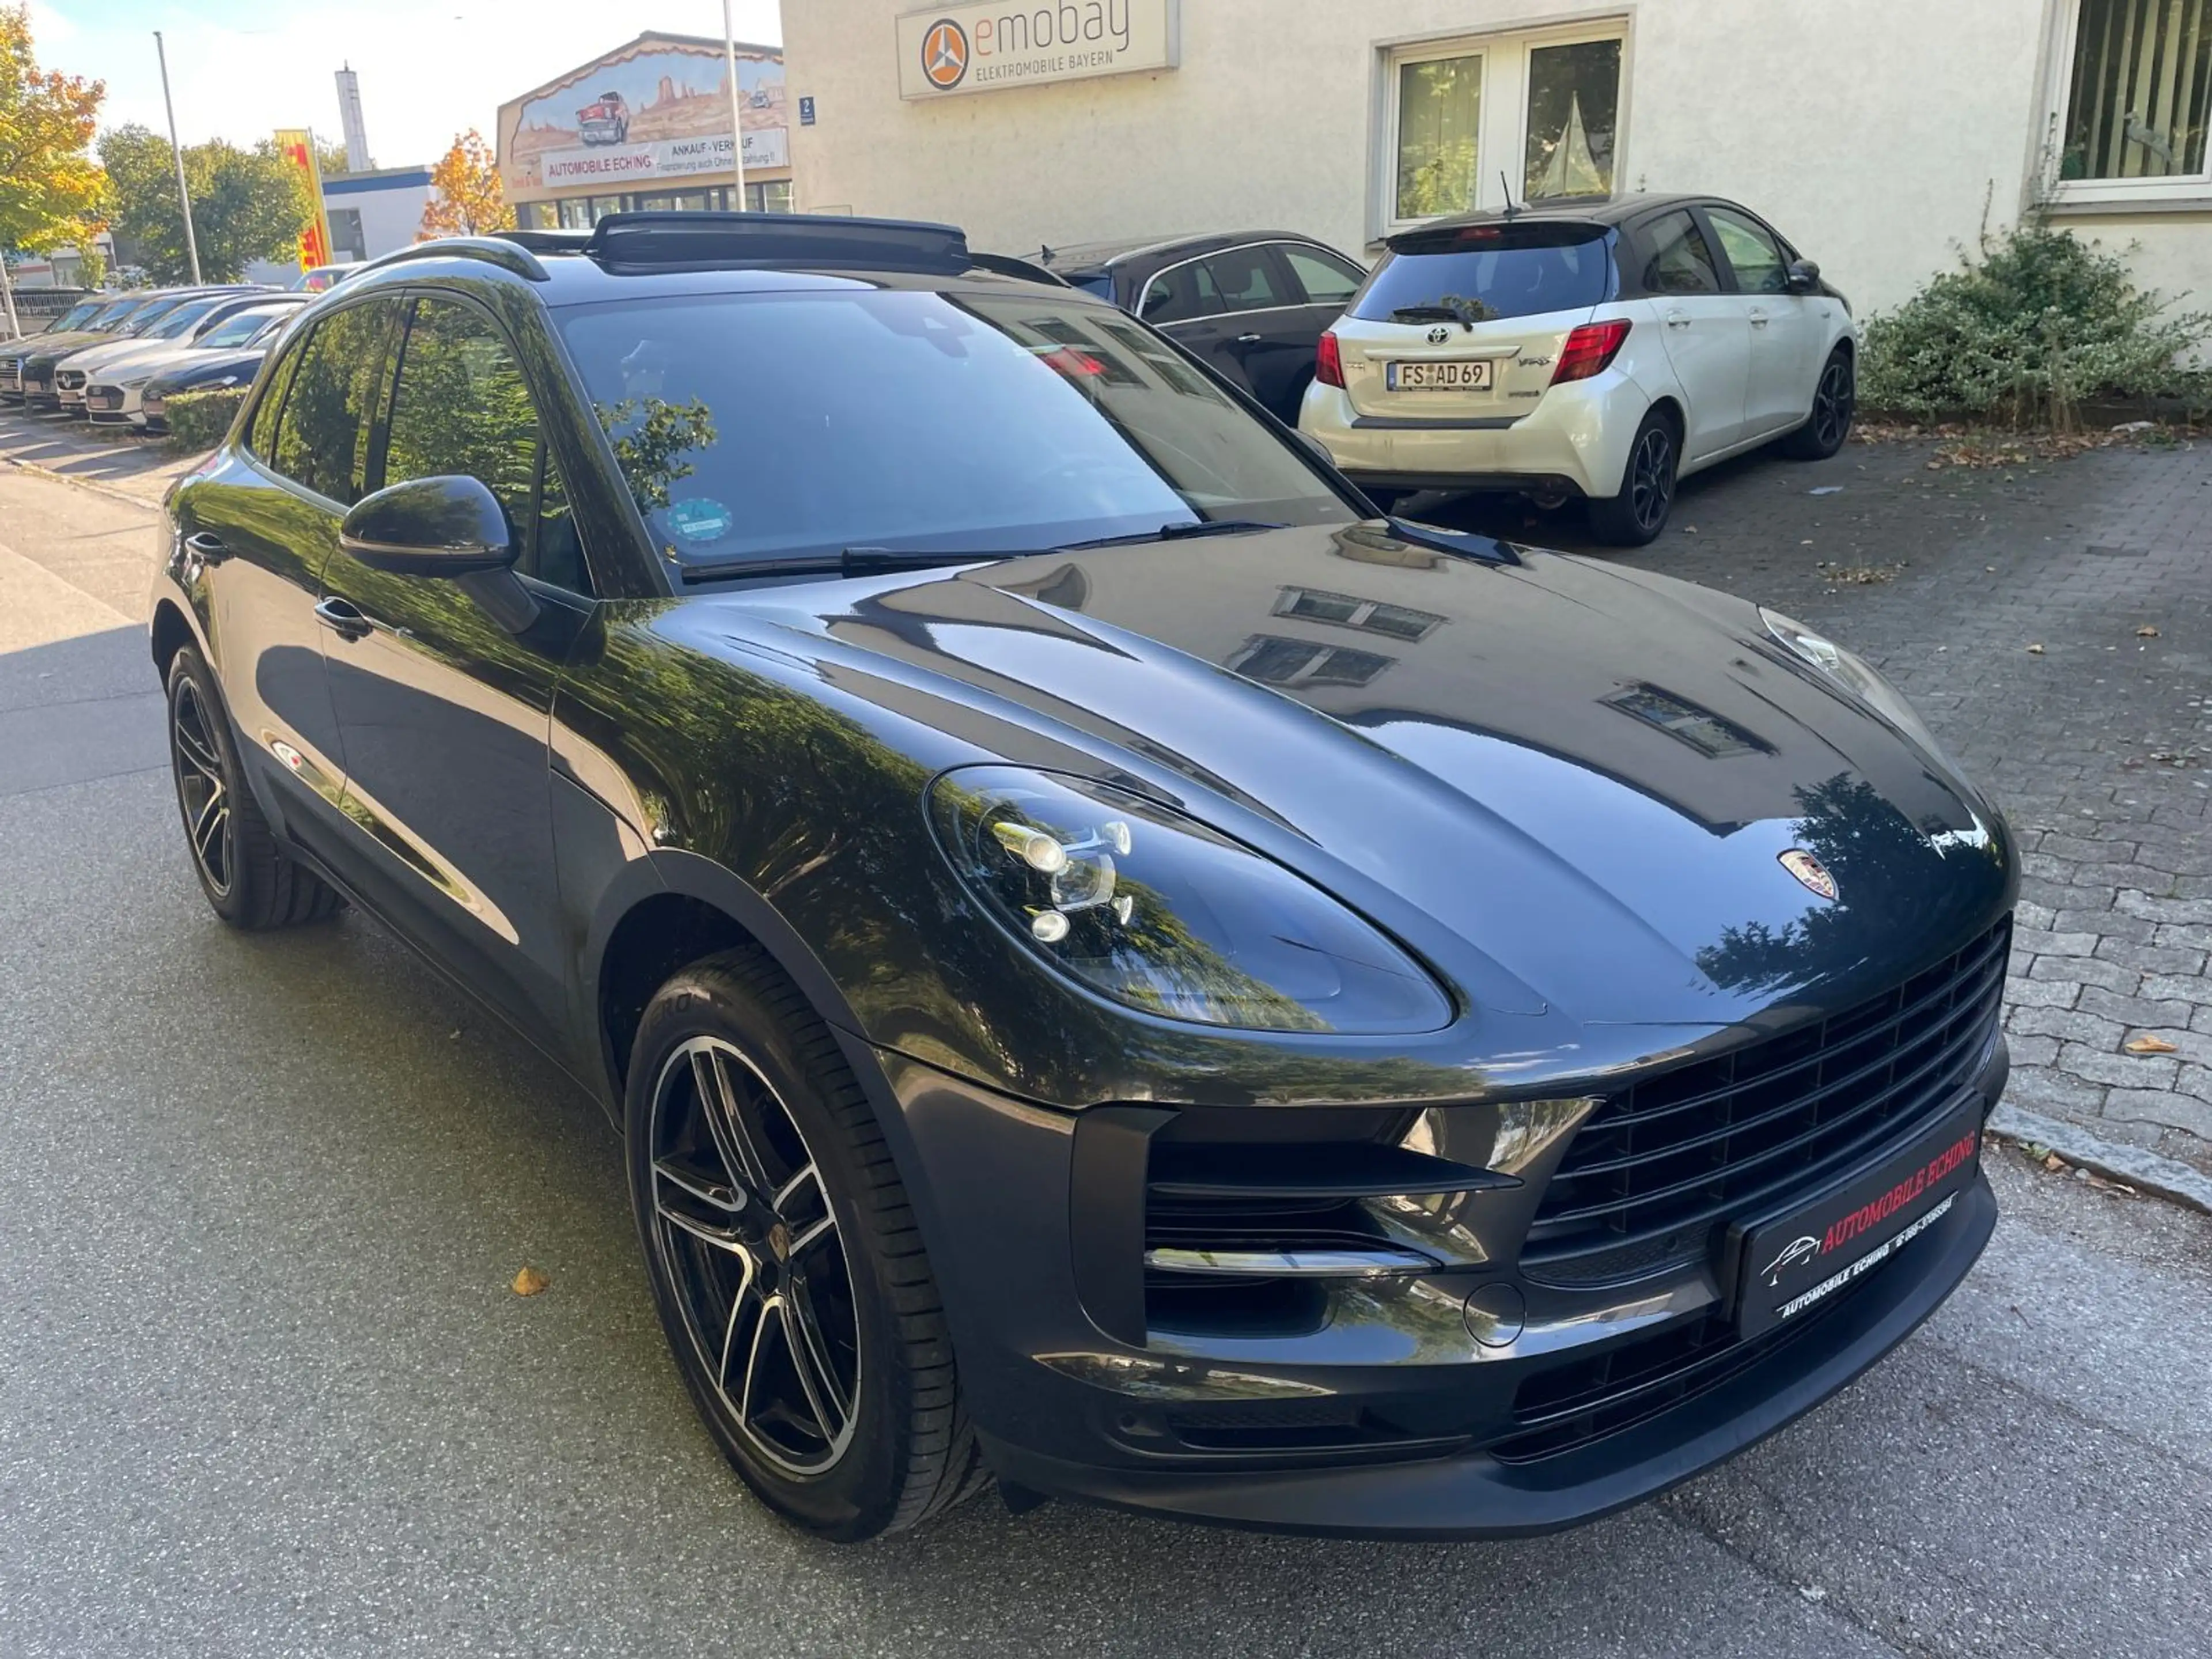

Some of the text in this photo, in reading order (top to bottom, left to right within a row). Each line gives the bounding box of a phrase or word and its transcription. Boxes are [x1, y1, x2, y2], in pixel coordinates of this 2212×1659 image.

[976, 0, 1129, 56] emobay
[976, 50, 1113, 82] ELEKTROMOBILE BAYERN
[804, 99, 810, 113] 2
[672, 142, 707, 156] ANKAUF
[549, 154, 650, 178] AUTOMOBILE ECHING
[1403, 365, 1483, 384] FS AD 69
[1821, 1168, 1926, 1255] AUTOMOBILE
[1926, 1130, 1975, 1187] ECHING
[1782, 1244, 1890, 1319] AUTOMOBILE ECHING
